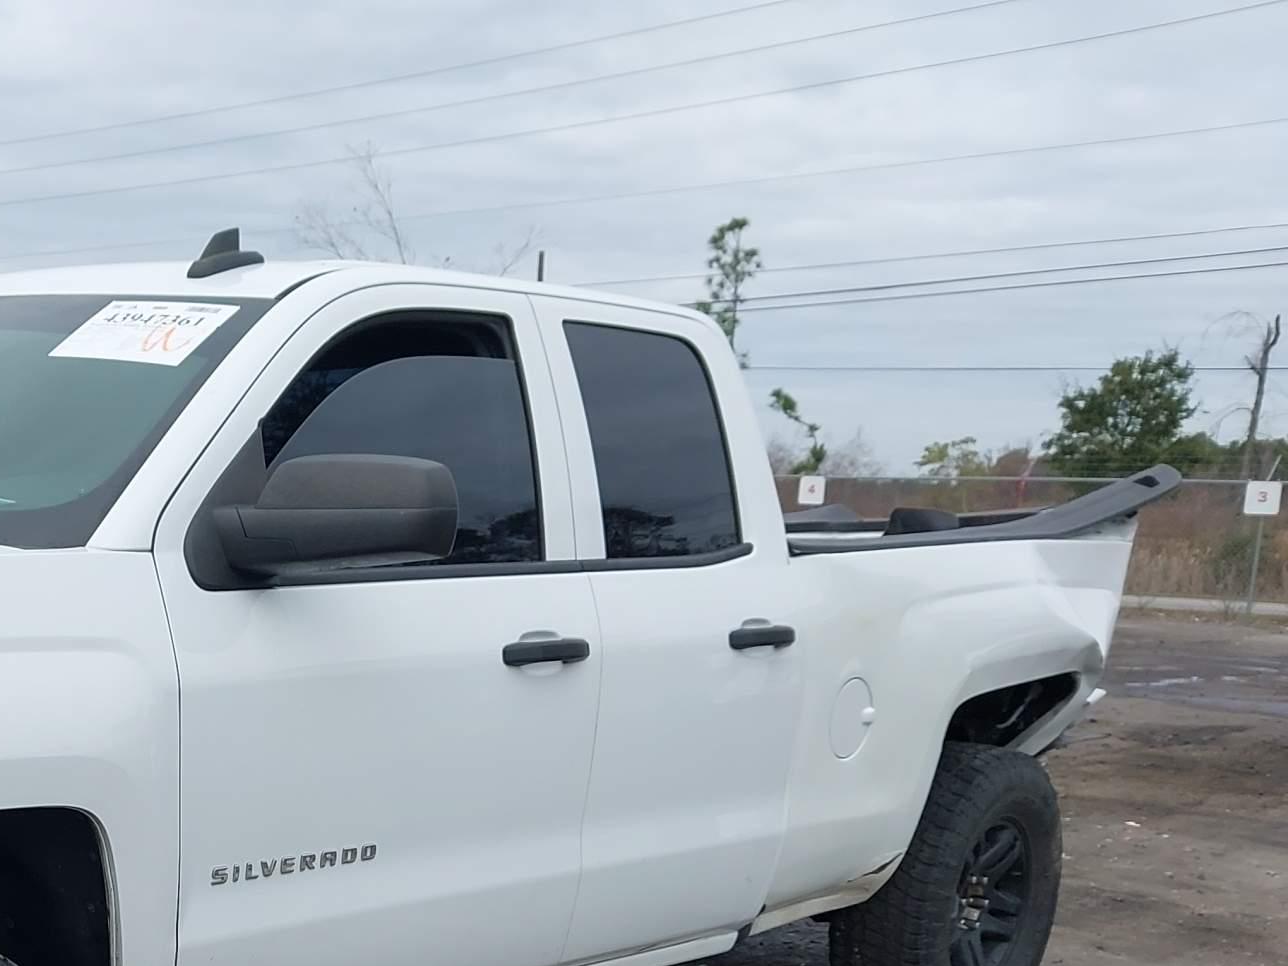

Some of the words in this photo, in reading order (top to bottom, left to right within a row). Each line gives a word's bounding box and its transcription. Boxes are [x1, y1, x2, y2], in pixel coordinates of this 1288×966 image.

[104, 312, 205, 327] 43947361
[1257, 491, 1268, 503] 3
[210, 844, 378, 886] SILVERADO
